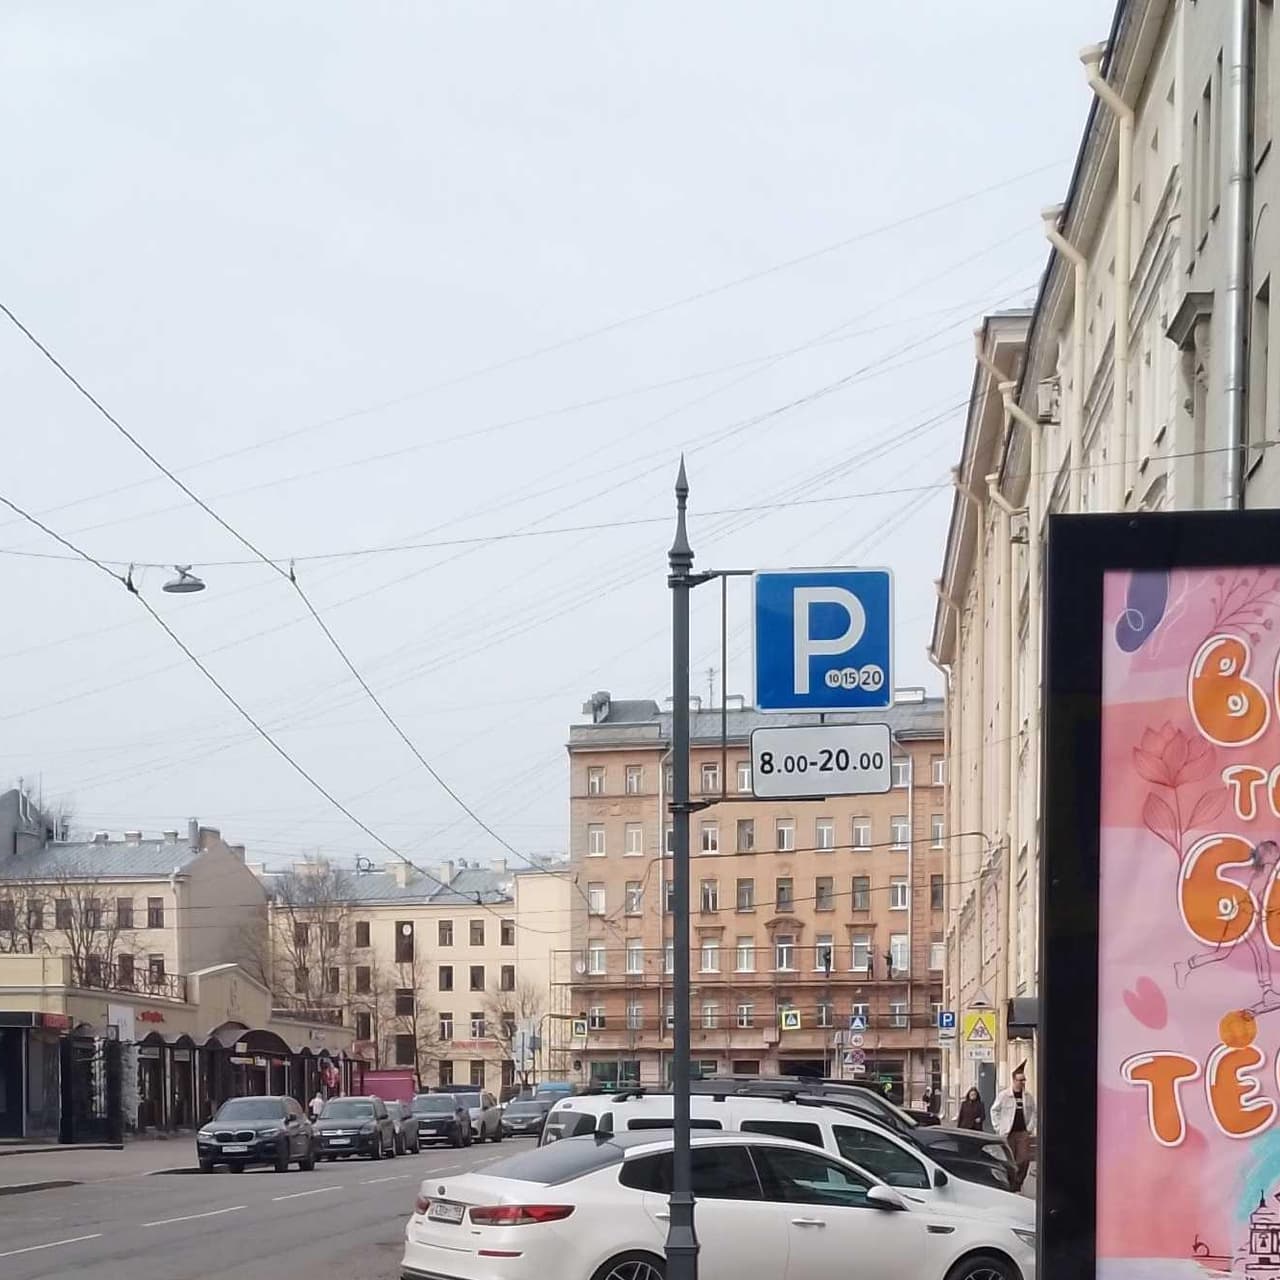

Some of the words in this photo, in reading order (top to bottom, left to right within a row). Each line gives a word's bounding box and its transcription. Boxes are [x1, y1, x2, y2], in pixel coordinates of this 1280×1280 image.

[793, 586, 866, 695] P
[828, 673, 839, 684] 10
[844, 672, 856, 685] 15
[862, 670, 882, 685] 20
[760, 749, 884, 775] 8.00-20.00
